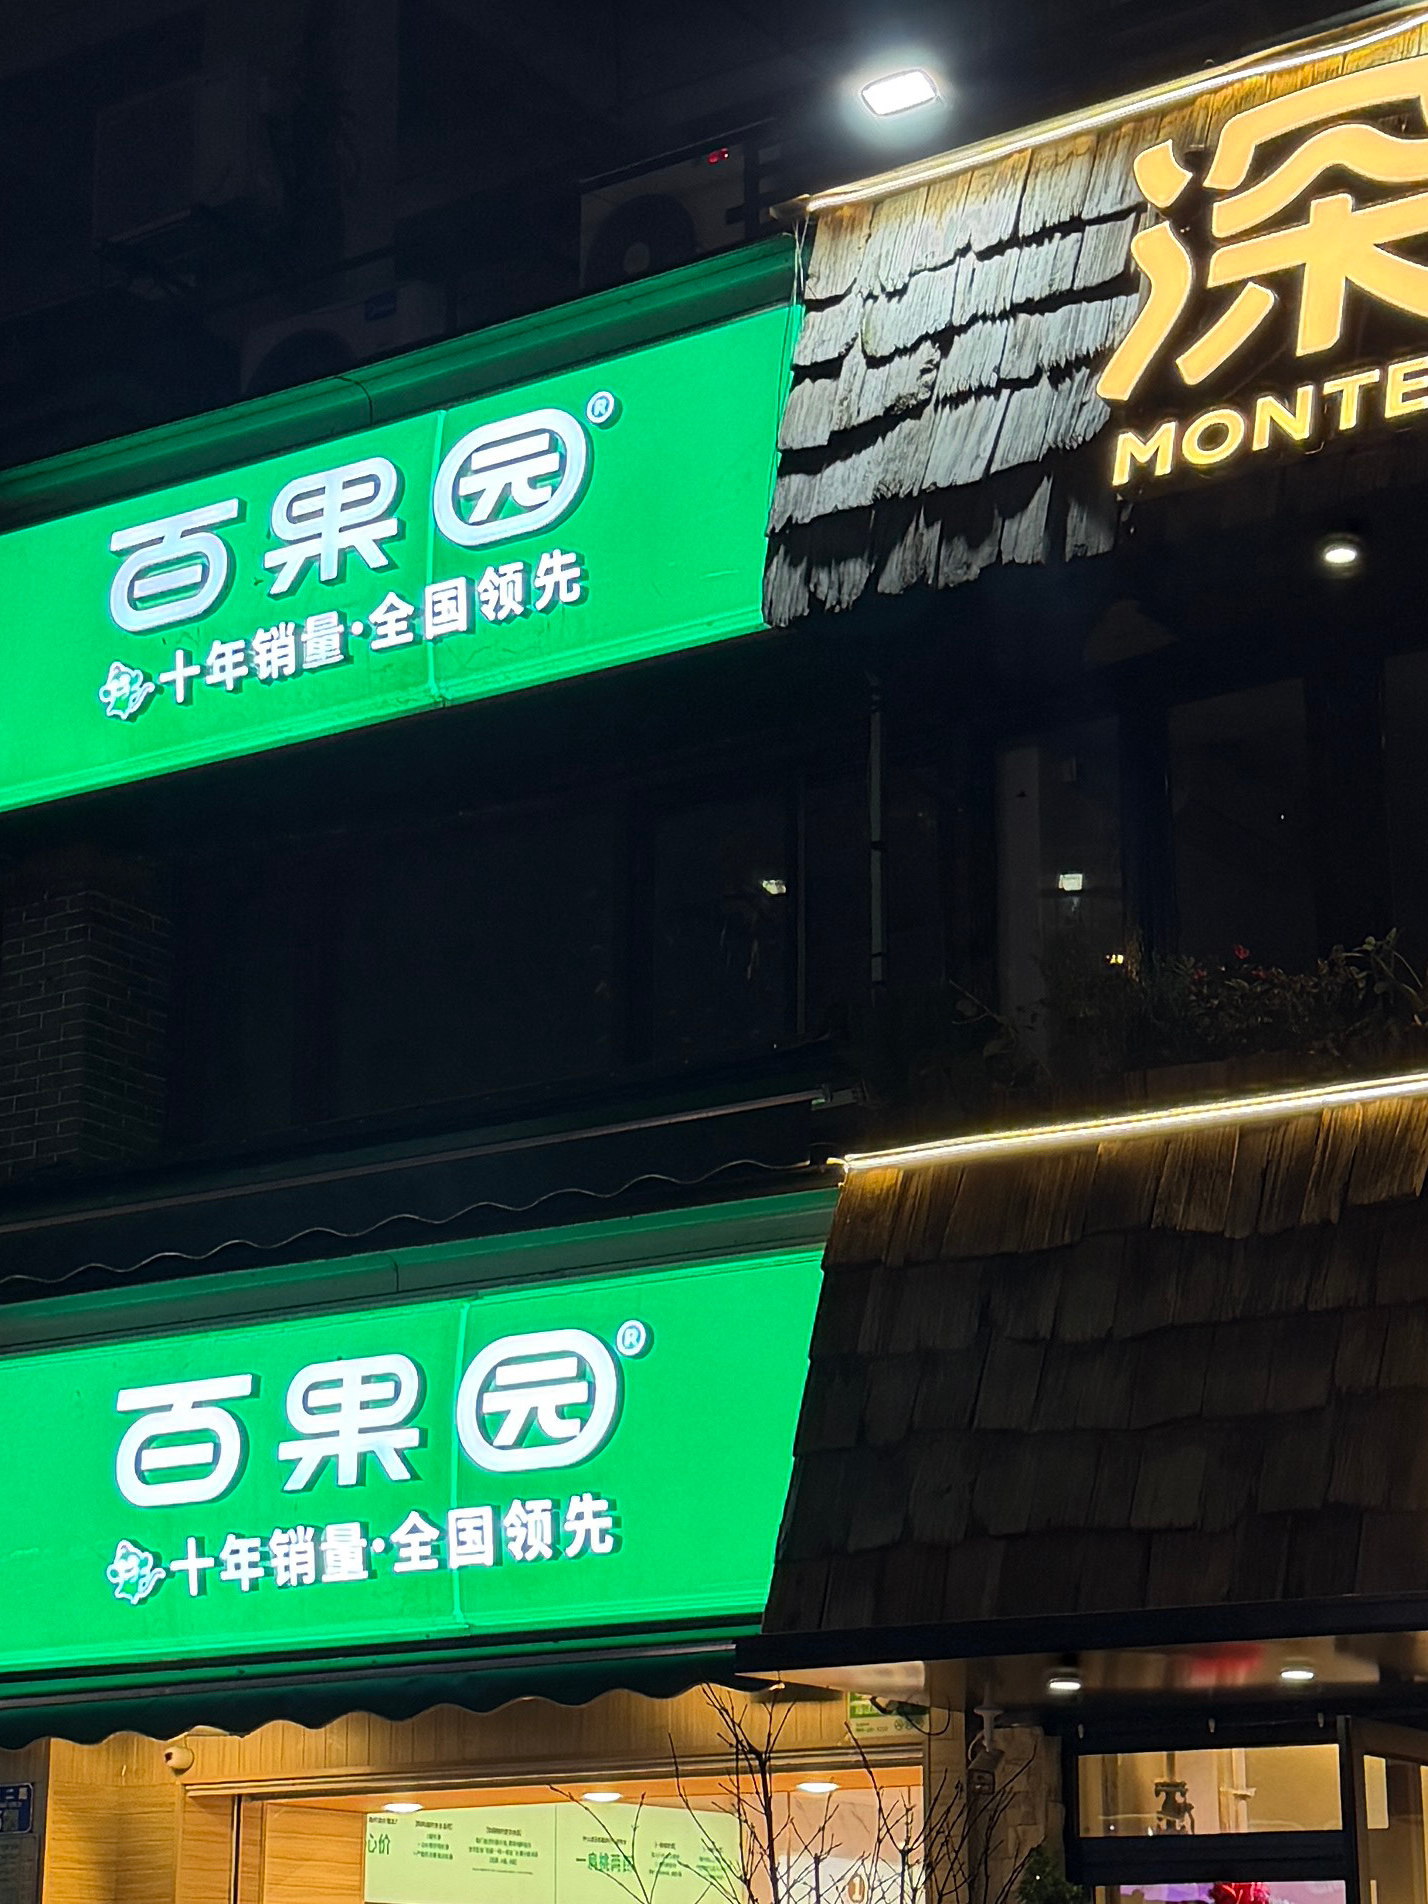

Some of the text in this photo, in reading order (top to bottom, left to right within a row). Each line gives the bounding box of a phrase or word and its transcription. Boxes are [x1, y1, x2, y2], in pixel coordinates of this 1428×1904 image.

[108, 408, 588, 632] 百果园
[159, 549, 582, 703] 十年销量·全国领先
[115, 1328, 618, 1507] 百果园
[169, 1493, 615, 1597] 十年销量·全国领先
